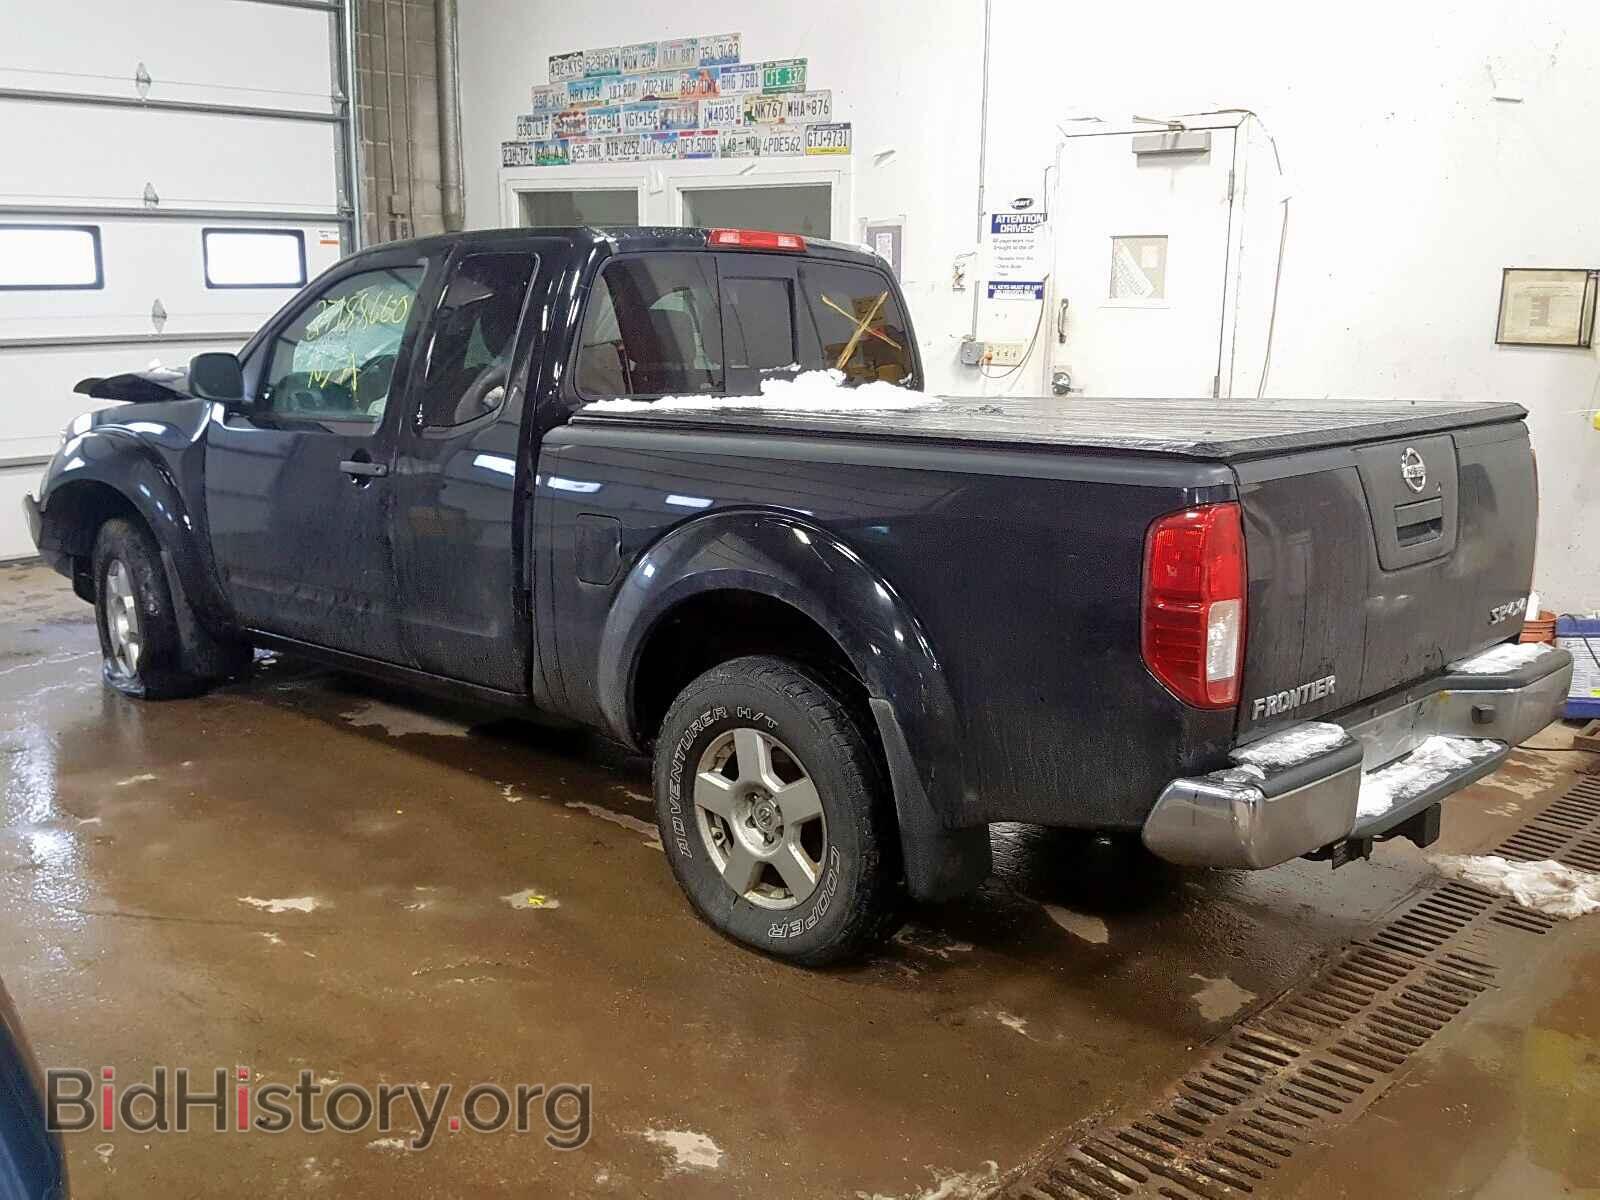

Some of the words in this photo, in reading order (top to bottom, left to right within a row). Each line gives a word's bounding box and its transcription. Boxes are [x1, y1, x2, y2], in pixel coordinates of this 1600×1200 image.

[762, 136, 801, 153] 4PDE562
[995, 214, 1042, 224] ATTENTION
[1251, 674, 1337, 720] FRONTIER
[669, 706, 728, 859] ADVENTURER
[737, 706, 779, 729] H/T
[768, 846, 841, 938] COOPER
